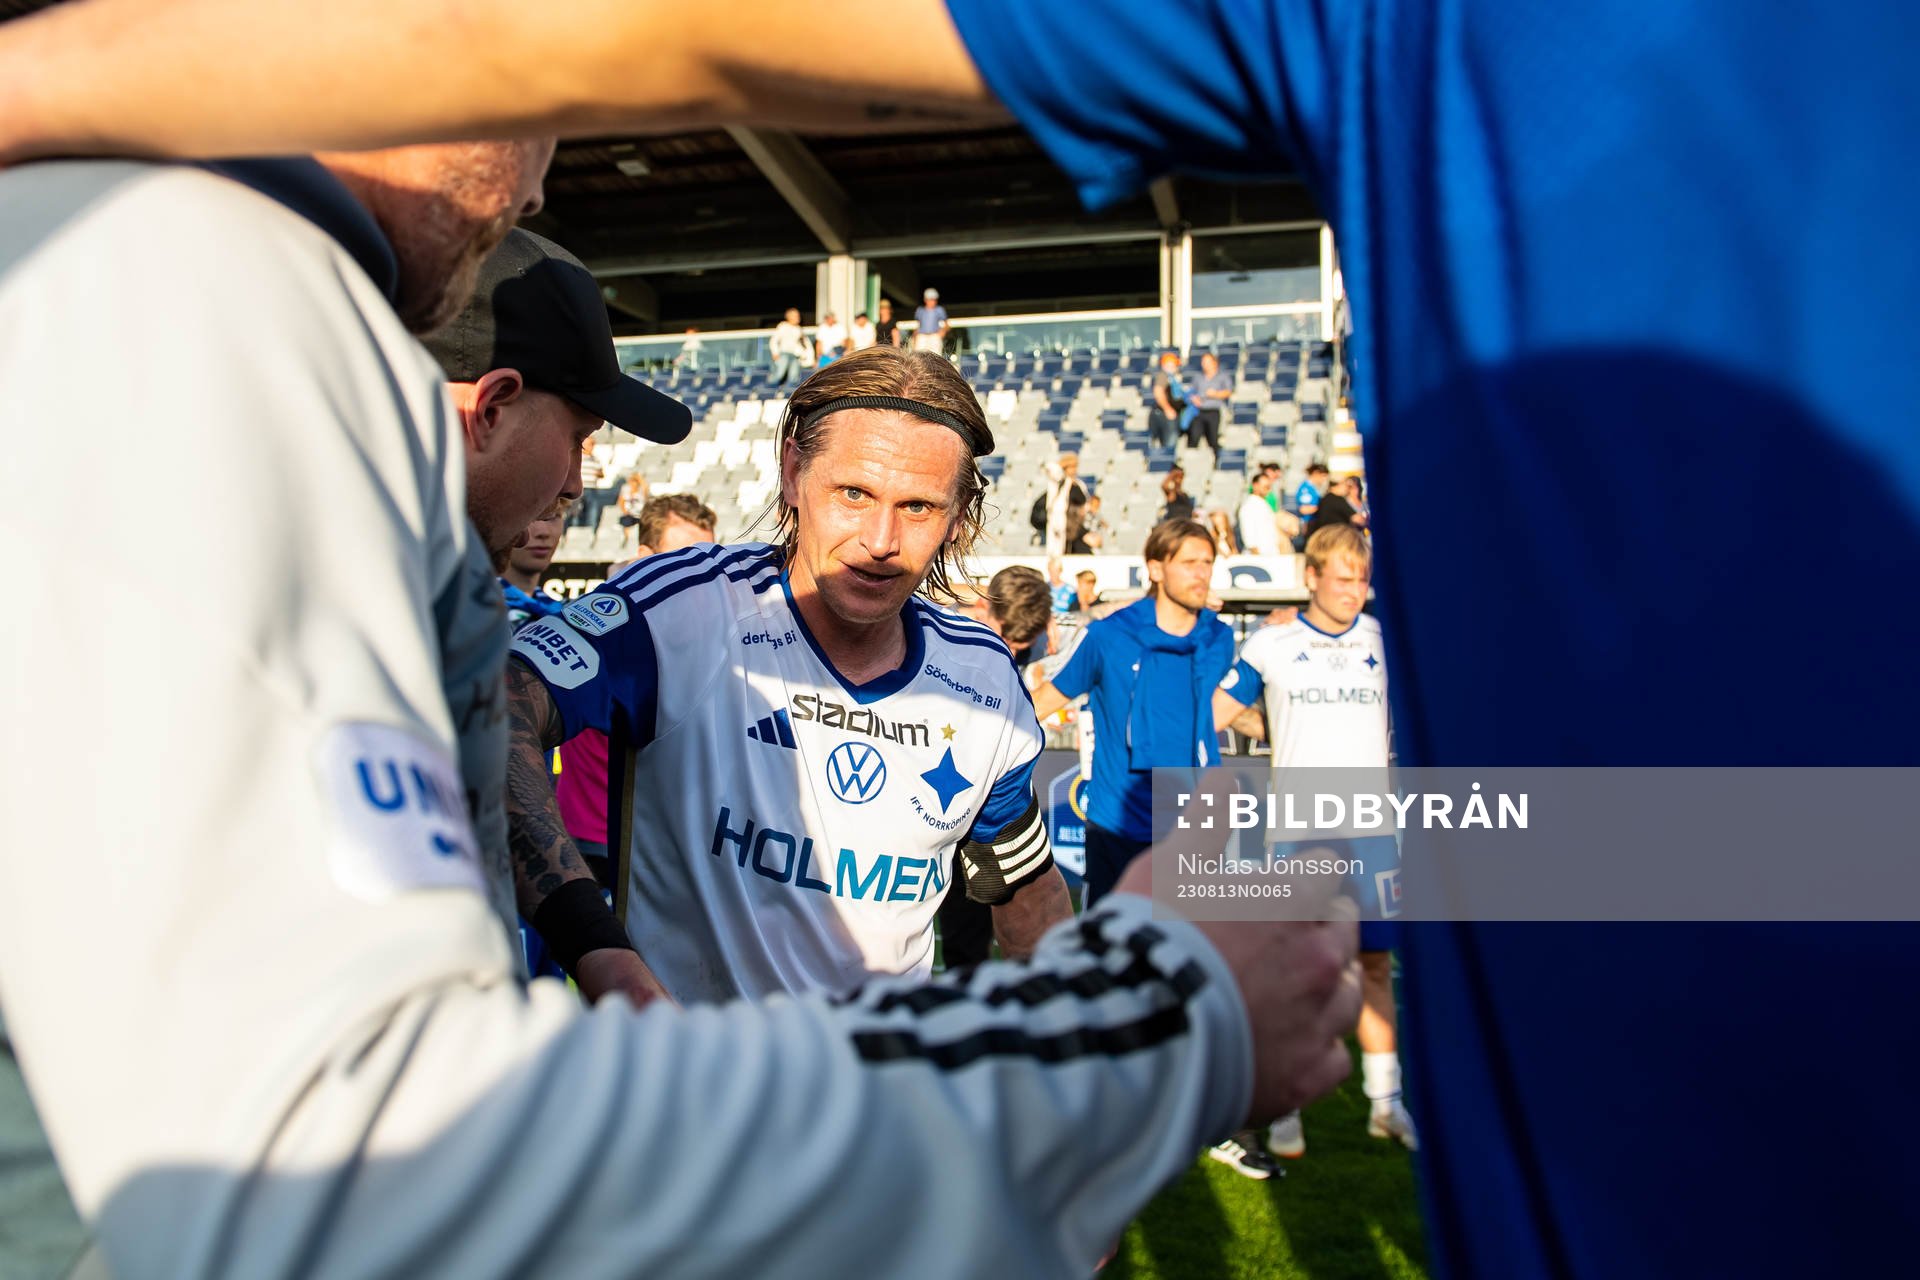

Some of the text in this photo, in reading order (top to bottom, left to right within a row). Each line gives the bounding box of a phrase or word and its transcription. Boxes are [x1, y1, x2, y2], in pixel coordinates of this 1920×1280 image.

[984, 695, 1001, 710] Bil
[1288, 688, 1384, 706] HOLMEN
[791, 693, 929, 746] stadium
[910, 796, 923, 814] IFK
[711, 807, 945, 902] HOLMEN
